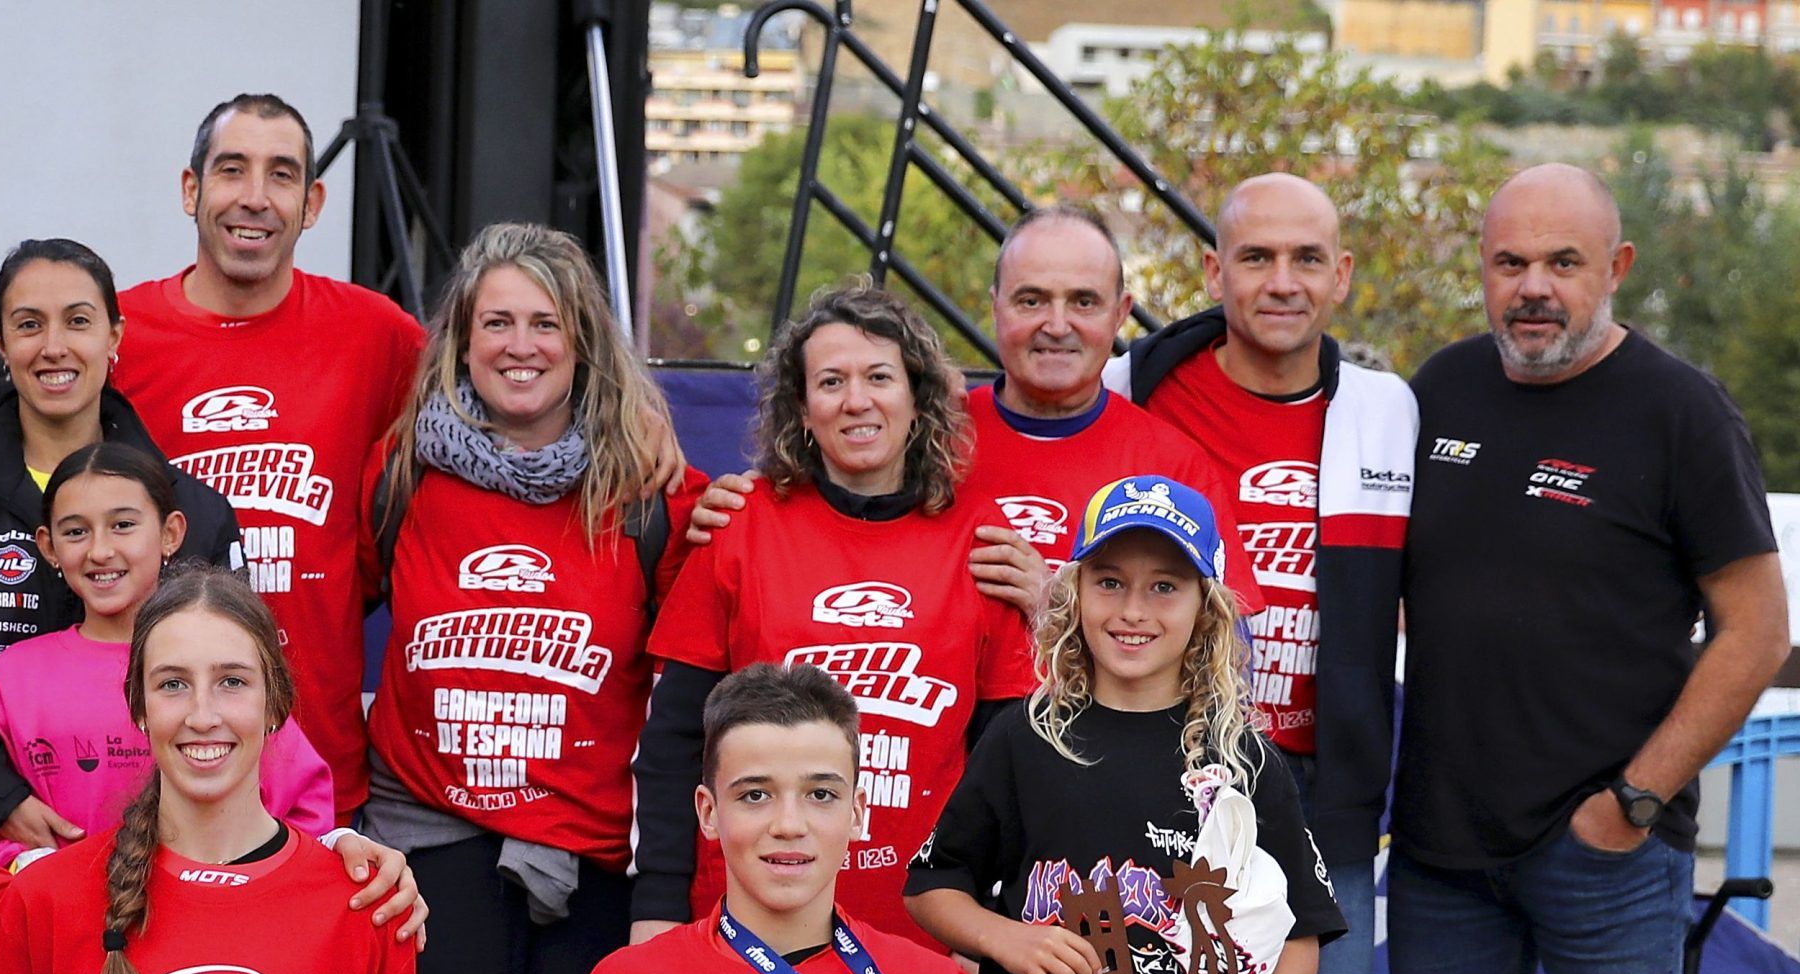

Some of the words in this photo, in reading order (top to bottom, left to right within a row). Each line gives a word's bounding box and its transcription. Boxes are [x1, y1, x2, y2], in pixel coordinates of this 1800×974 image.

[182, 416, 270, 433] Beta
[1360, 467, 1411, 482] Beta
[1100, 504, 1200, 538] MICHELIN
[458, 573, 547, 594] Beta
[812, 606, 905, 629] Beta
[433, 688, 567, 726] CAMPEONA
[106, 735, 123, 745] La
[436, 722, 464, 755] DE
[466, 719, 562, 760] ESPAÑA
[462, 757, 530, 788] TRIAL
[857, 845, 898, 870] 125
[179, 869, 250, 887] MOTS
[745, 944, 776, 973] rfme
